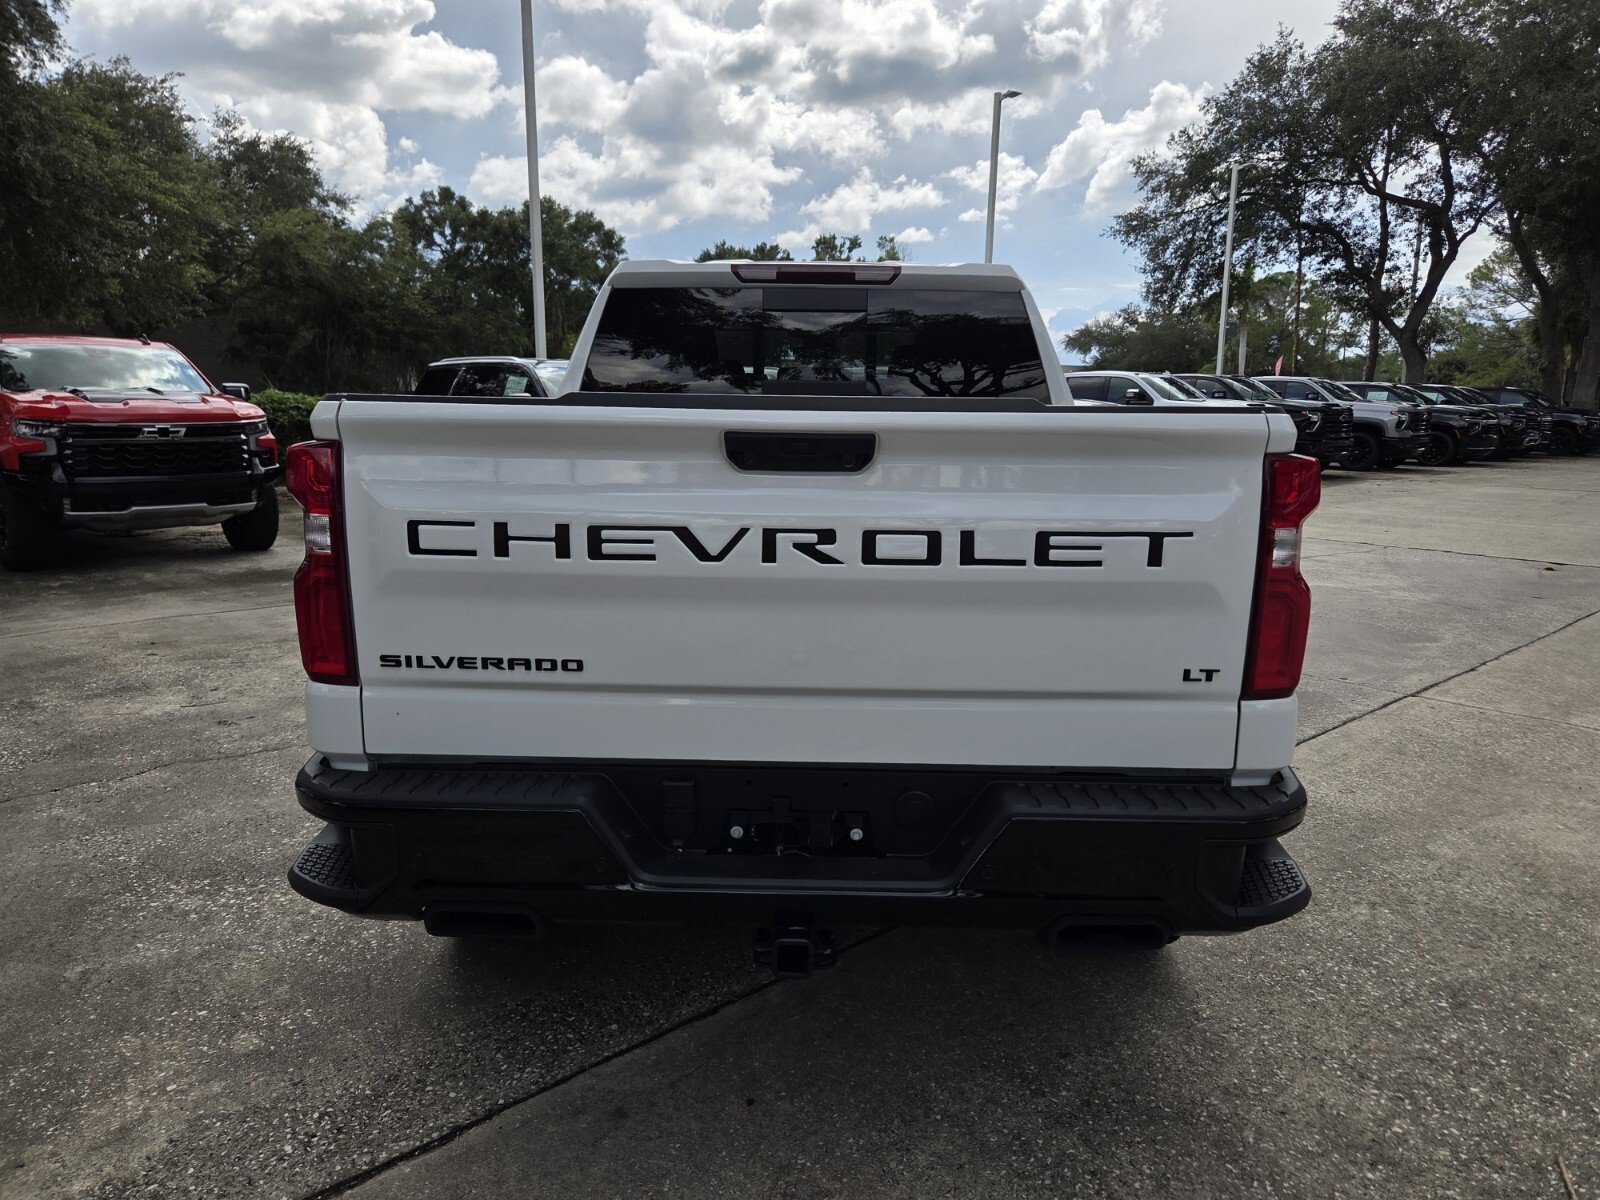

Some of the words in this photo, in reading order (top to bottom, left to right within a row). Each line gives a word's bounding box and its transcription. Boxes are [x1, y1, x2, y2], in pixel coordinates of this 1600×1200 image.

[407, 520, 1194, 568] CHEVROLET
[379, 654, 585, 673] SILVERADO
[1181, 668, 1221, 683] LT
